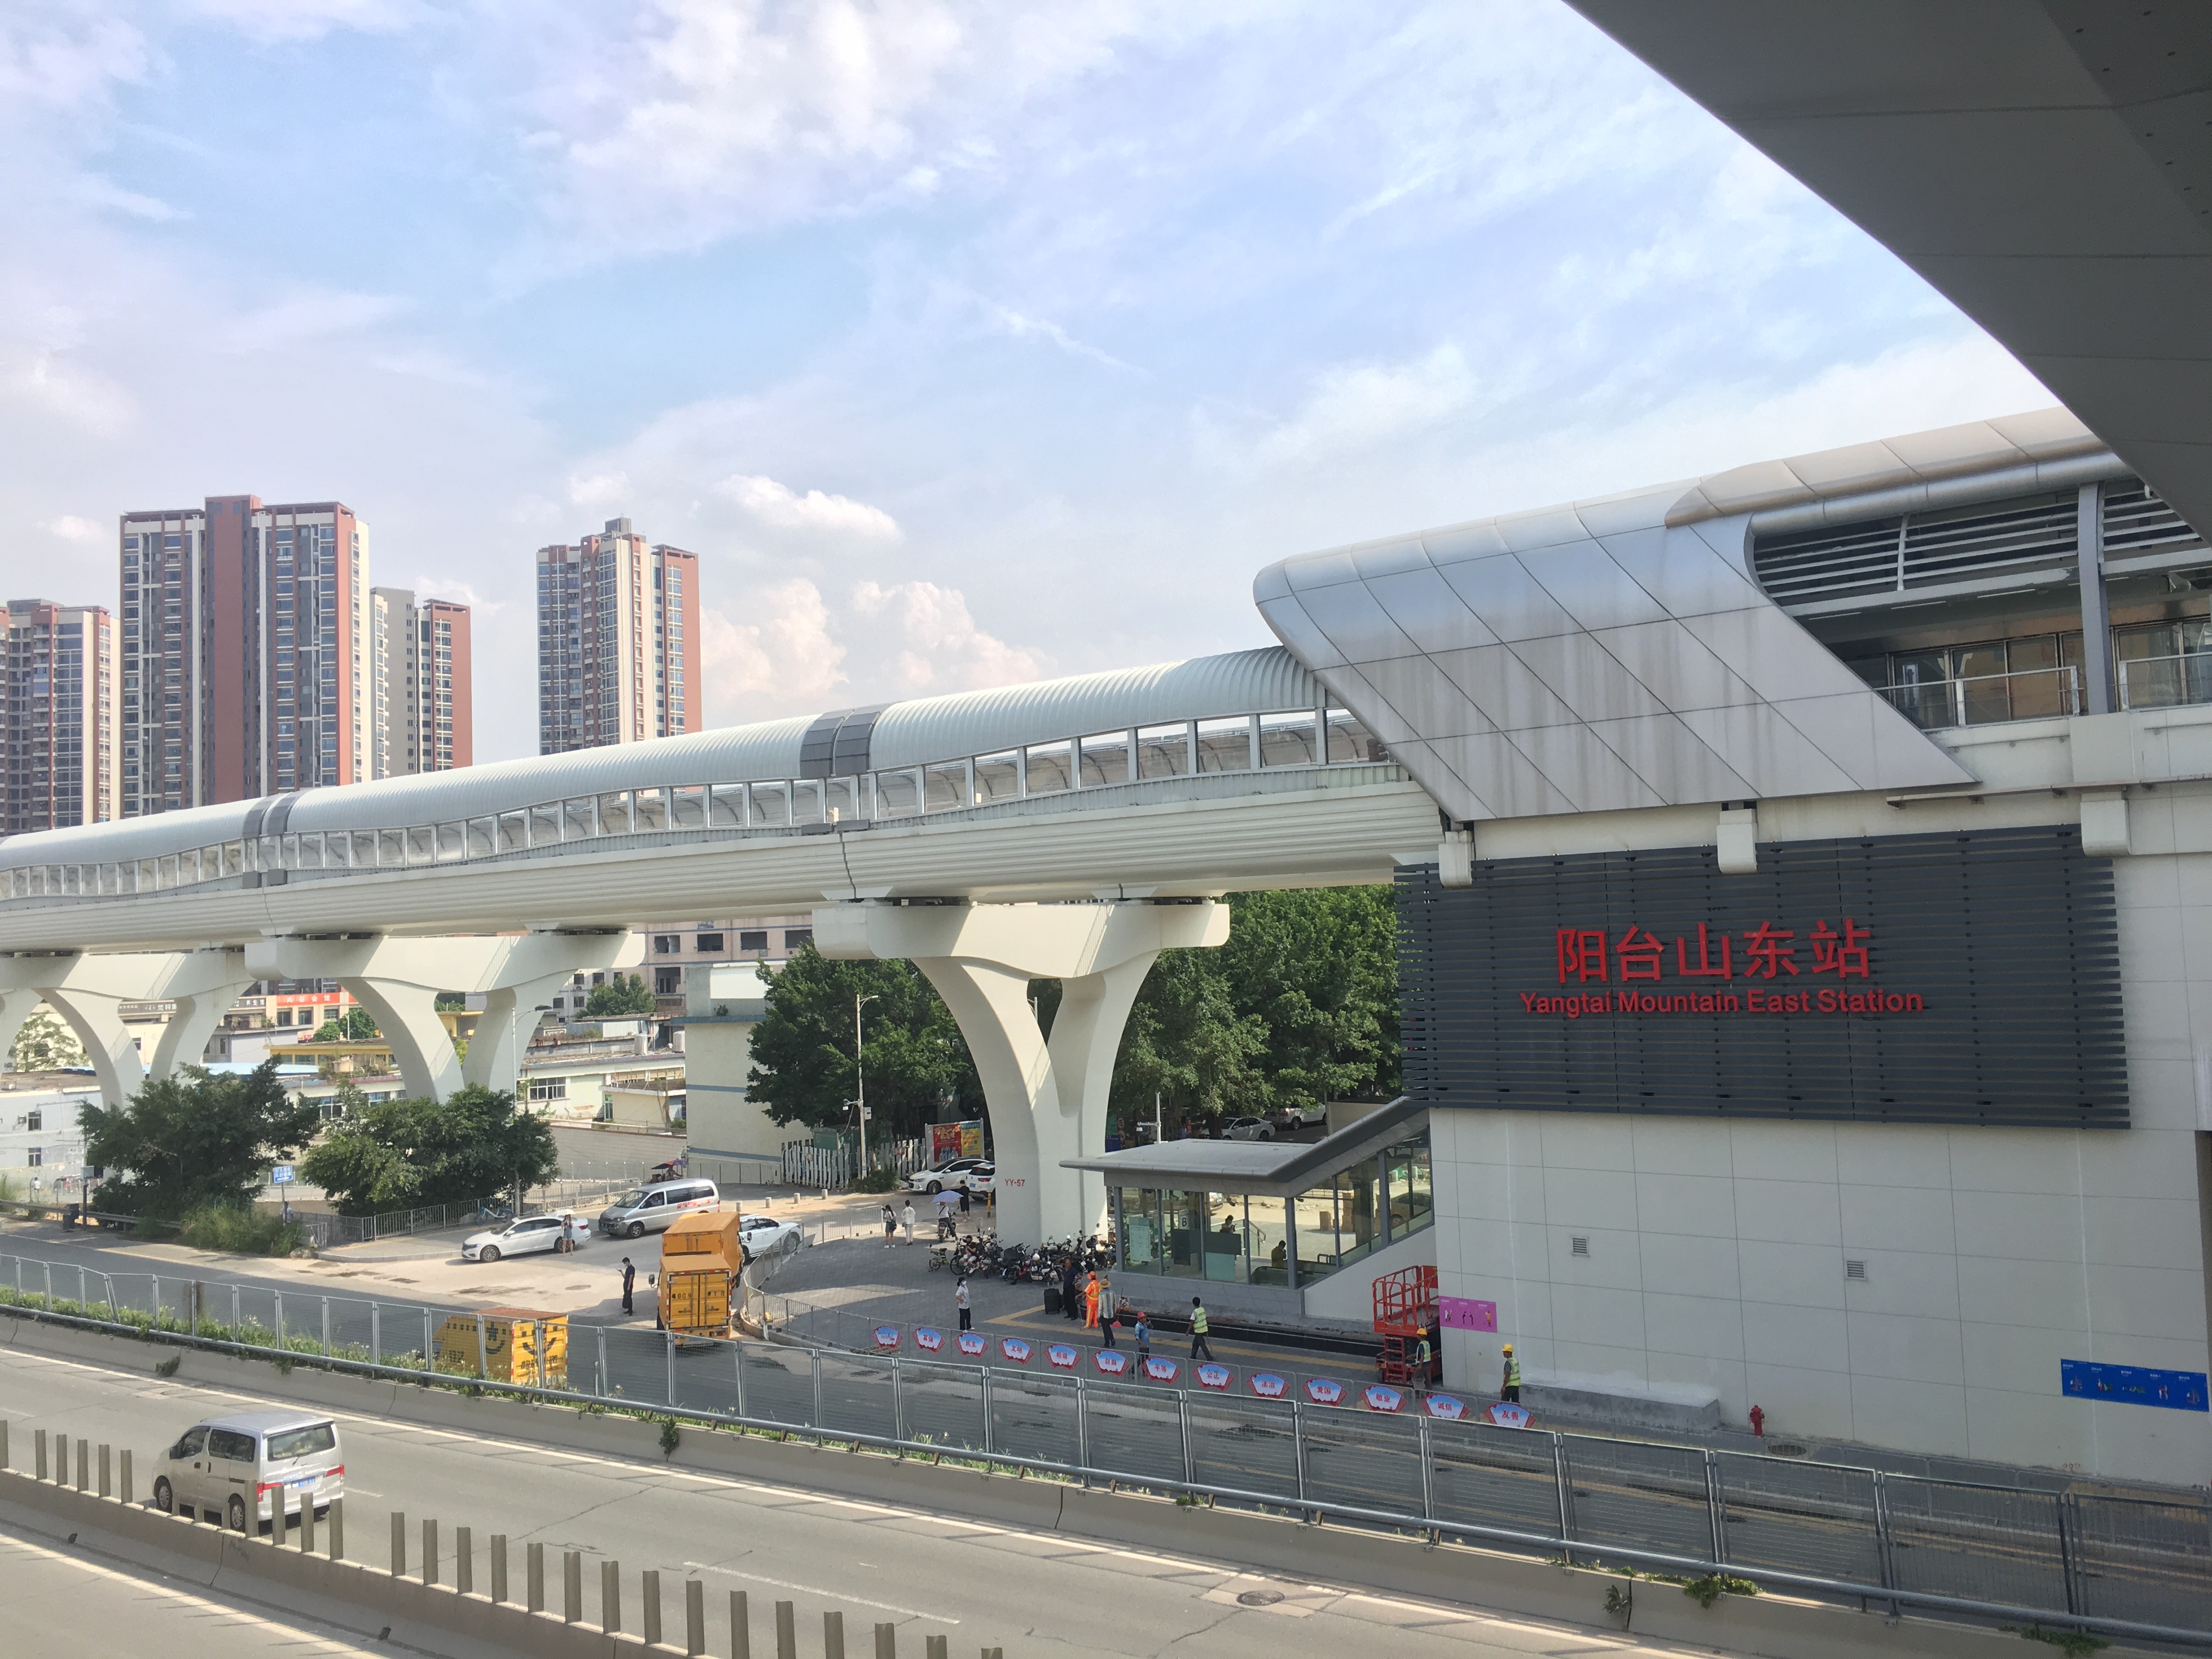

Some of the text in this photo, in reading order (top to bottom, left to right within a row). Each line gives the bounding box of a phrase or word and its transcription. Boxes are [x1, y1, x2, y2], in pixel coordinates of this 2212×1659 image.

[1556, 918, 1870, 984] 阳台山东站
[1519, 989, 1923, 1018] Yangtai Mountain East Station
[1005, 1178, 1025, 1187] YY-57
[1182, 1217, 1187, 1227] B
[966, 1339, 977, 1347] 民主
[1011, 1345, 1022, 1353] 文明
[1105, 1357, 1116, 1366] 自由
[1154, 1364, 1167, 1373] 平等
[1206, 1370, 1220, 1380] 公正
[1261, 1380, 1275, 1389] 法治
[1317, 1385, 1331, 1395] 爱国
[1375, 1393, 1391, 1403] 敬业
[1437, 1402, 1452, 1412] 诚信
[1502, 1409, 1519, 1420] 友善
